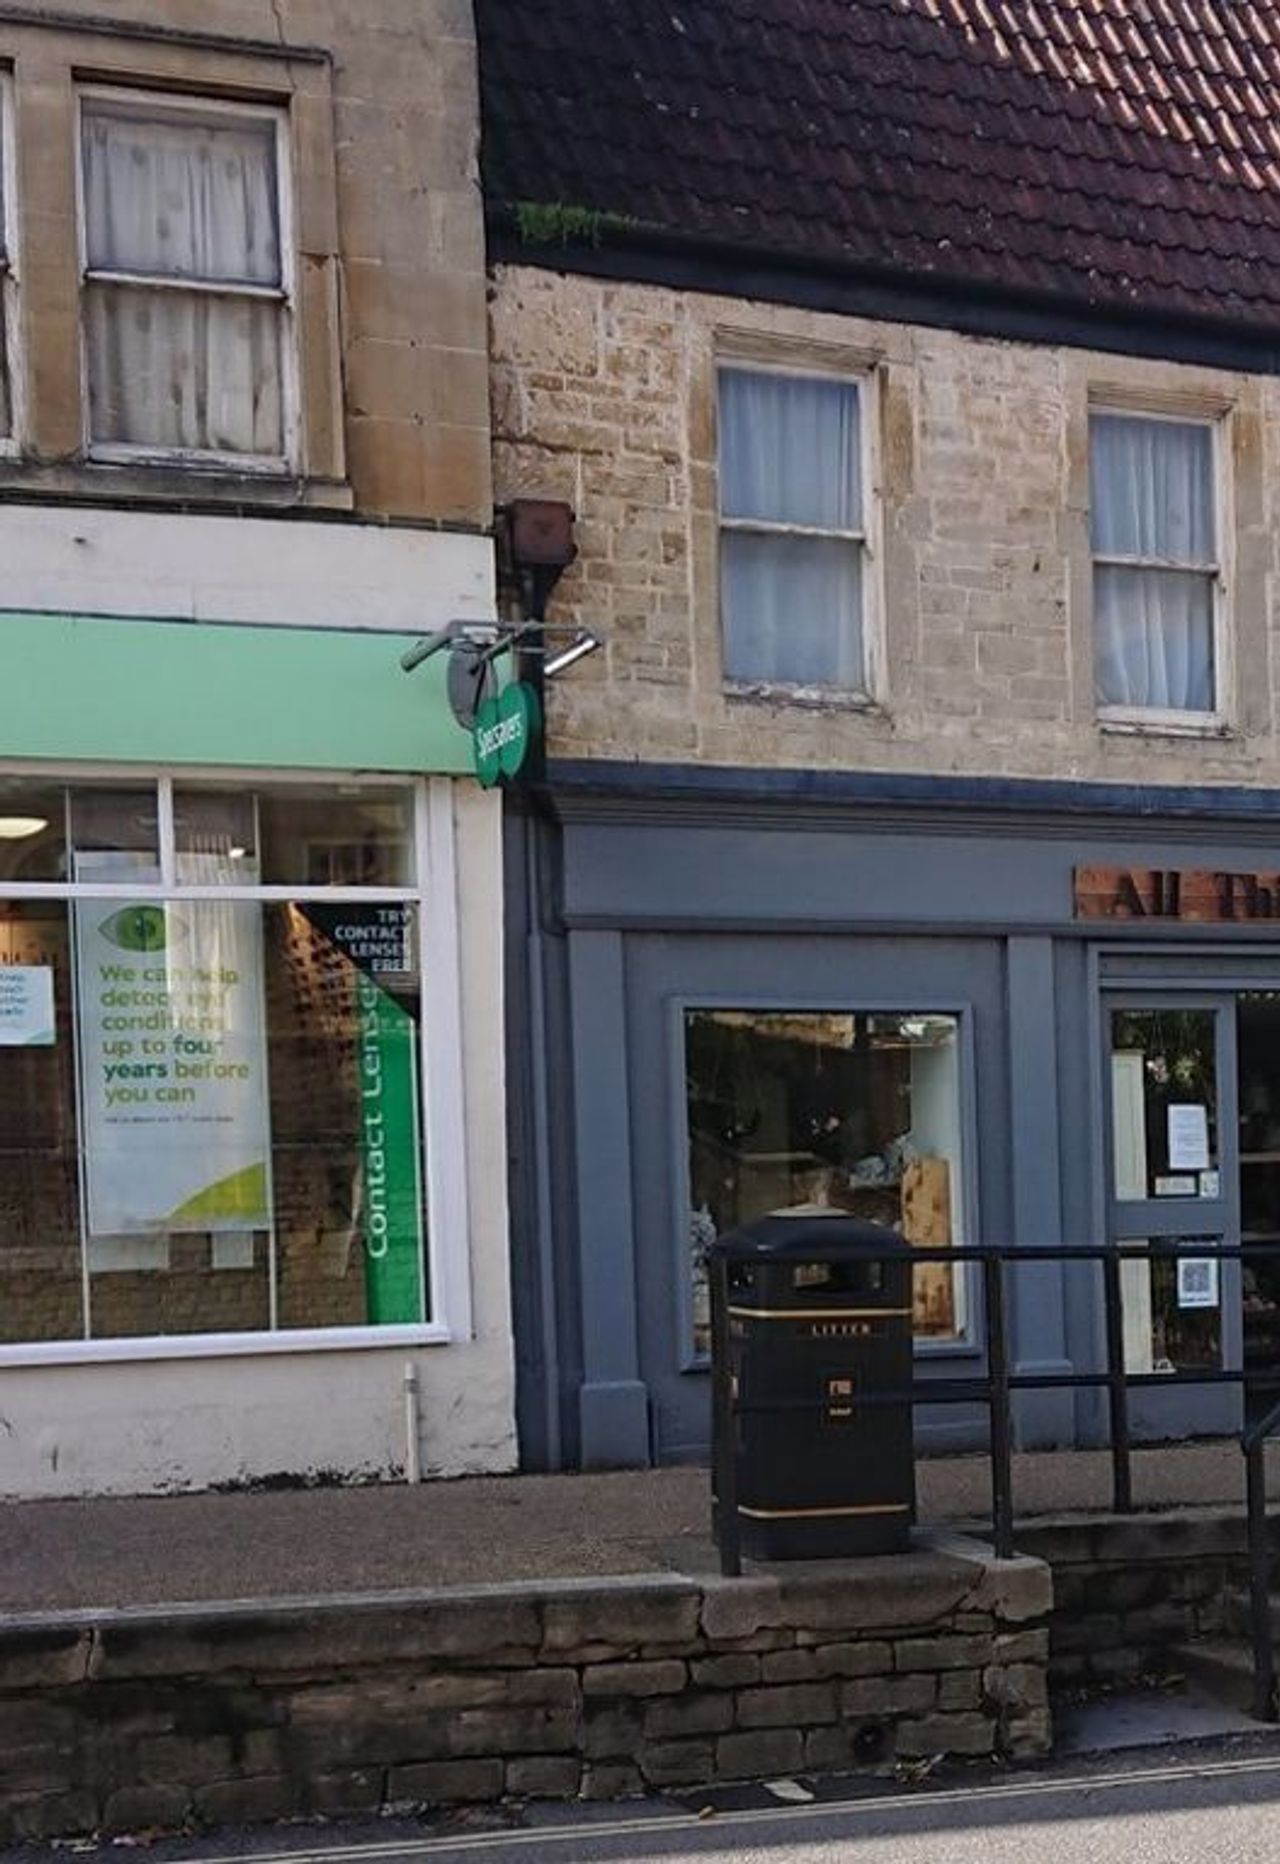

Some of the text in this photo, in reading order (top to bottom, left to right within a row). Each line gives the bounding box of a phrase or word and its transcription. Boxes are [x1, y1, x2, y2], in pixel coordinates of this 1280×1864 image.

[1112, 870, 1181, 917] All
[376, 910, 412, 923] TRY
[334, 925, 409, 940] CONTAC
[350, 942, 410, 956] LENSE
[100, 963, 137, 982] We
[371, 958, 411, 972] FRE
[101, 988, 181, 1008] detec
[103, 1040, 133, 1059] up
[142, 1039, 166, 1054] to
[103, 1059, 250, 1083] years before
[105, 1086, 196, 1107] you can
[366, 1111, 387, 1259] Contact
[812, 1323, 871, 1337] LITTER
